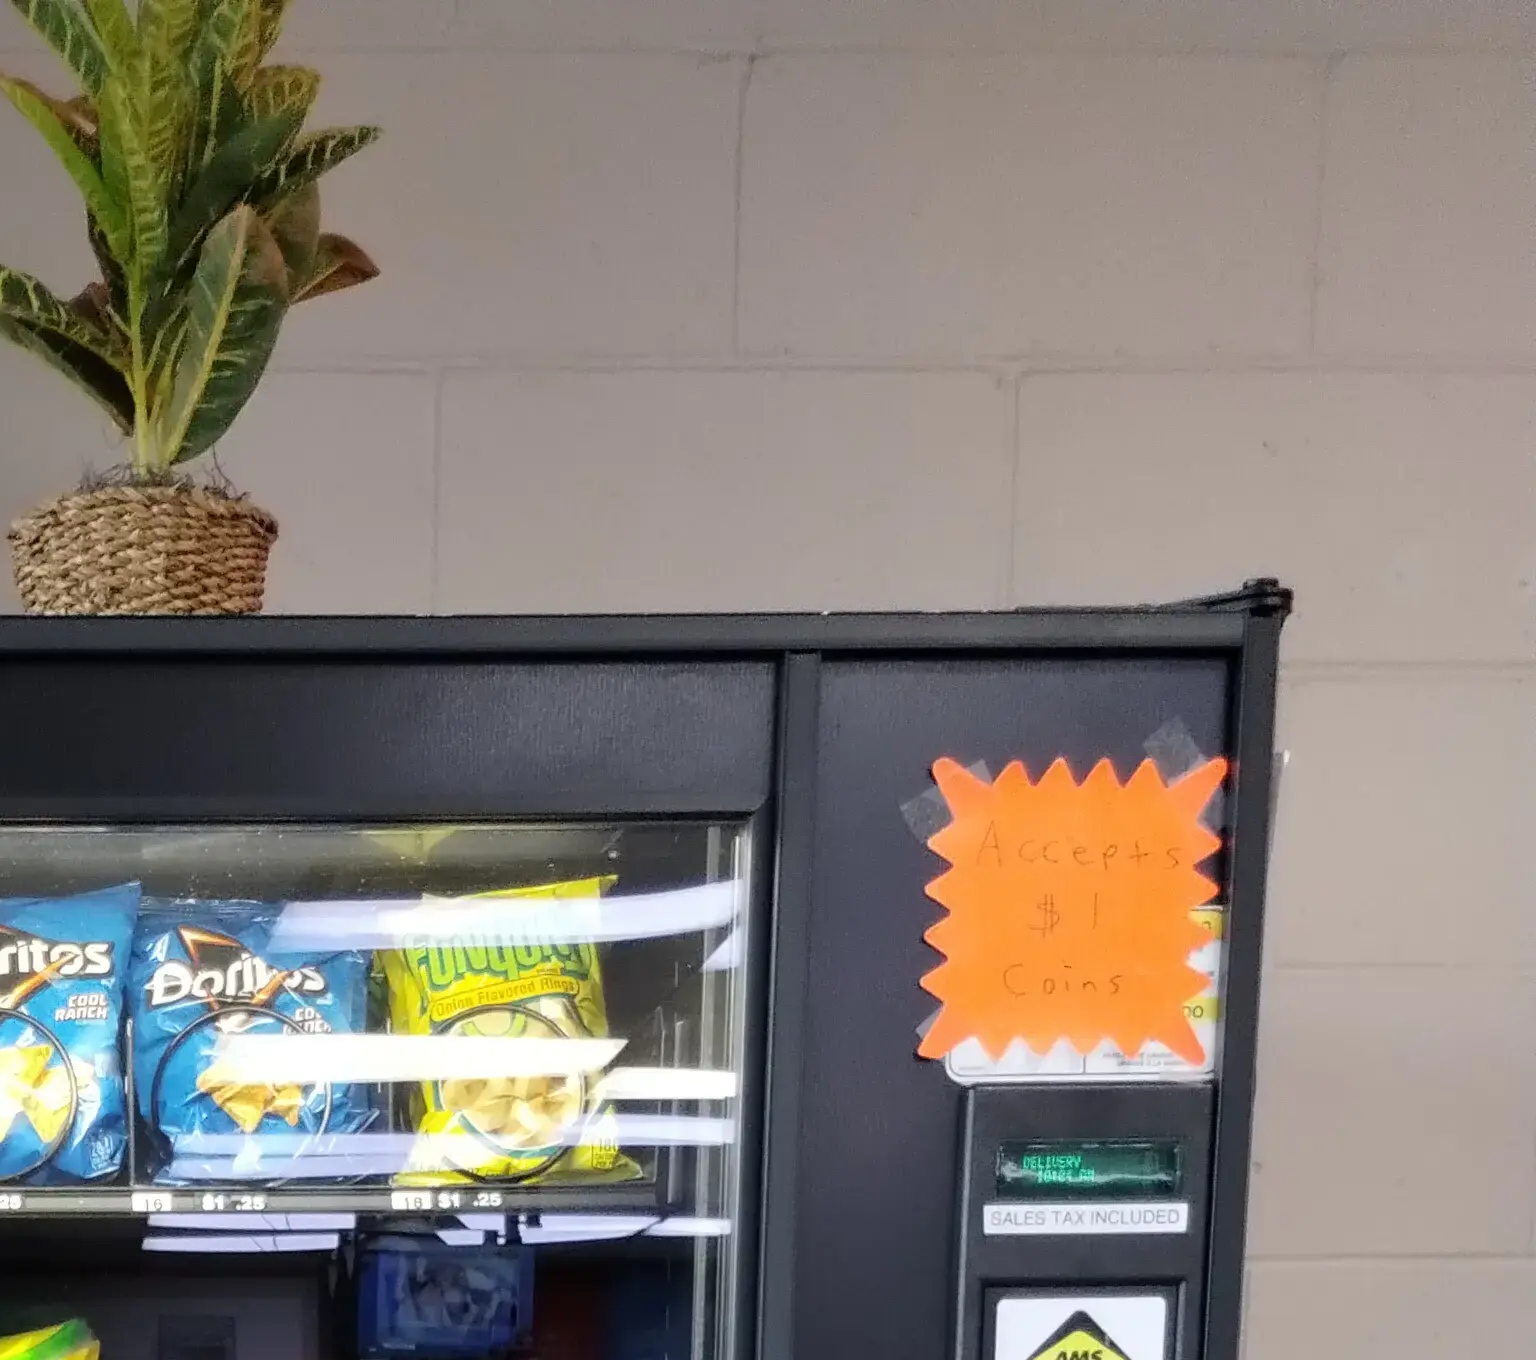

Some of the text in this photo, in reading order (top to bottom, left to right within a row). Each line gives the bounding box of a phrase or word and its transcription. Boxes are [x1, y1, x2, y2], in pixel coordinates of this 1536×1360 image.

[976, 821, 1182, 870] Accepts
[1003, 960, 1123, 997] Coins
[68, 992, 109, 1009] COOL
[54, 1003, 109, 1021] RANCH
[990, 1208, 1181, 1227] SALES TAX INCLUDED
